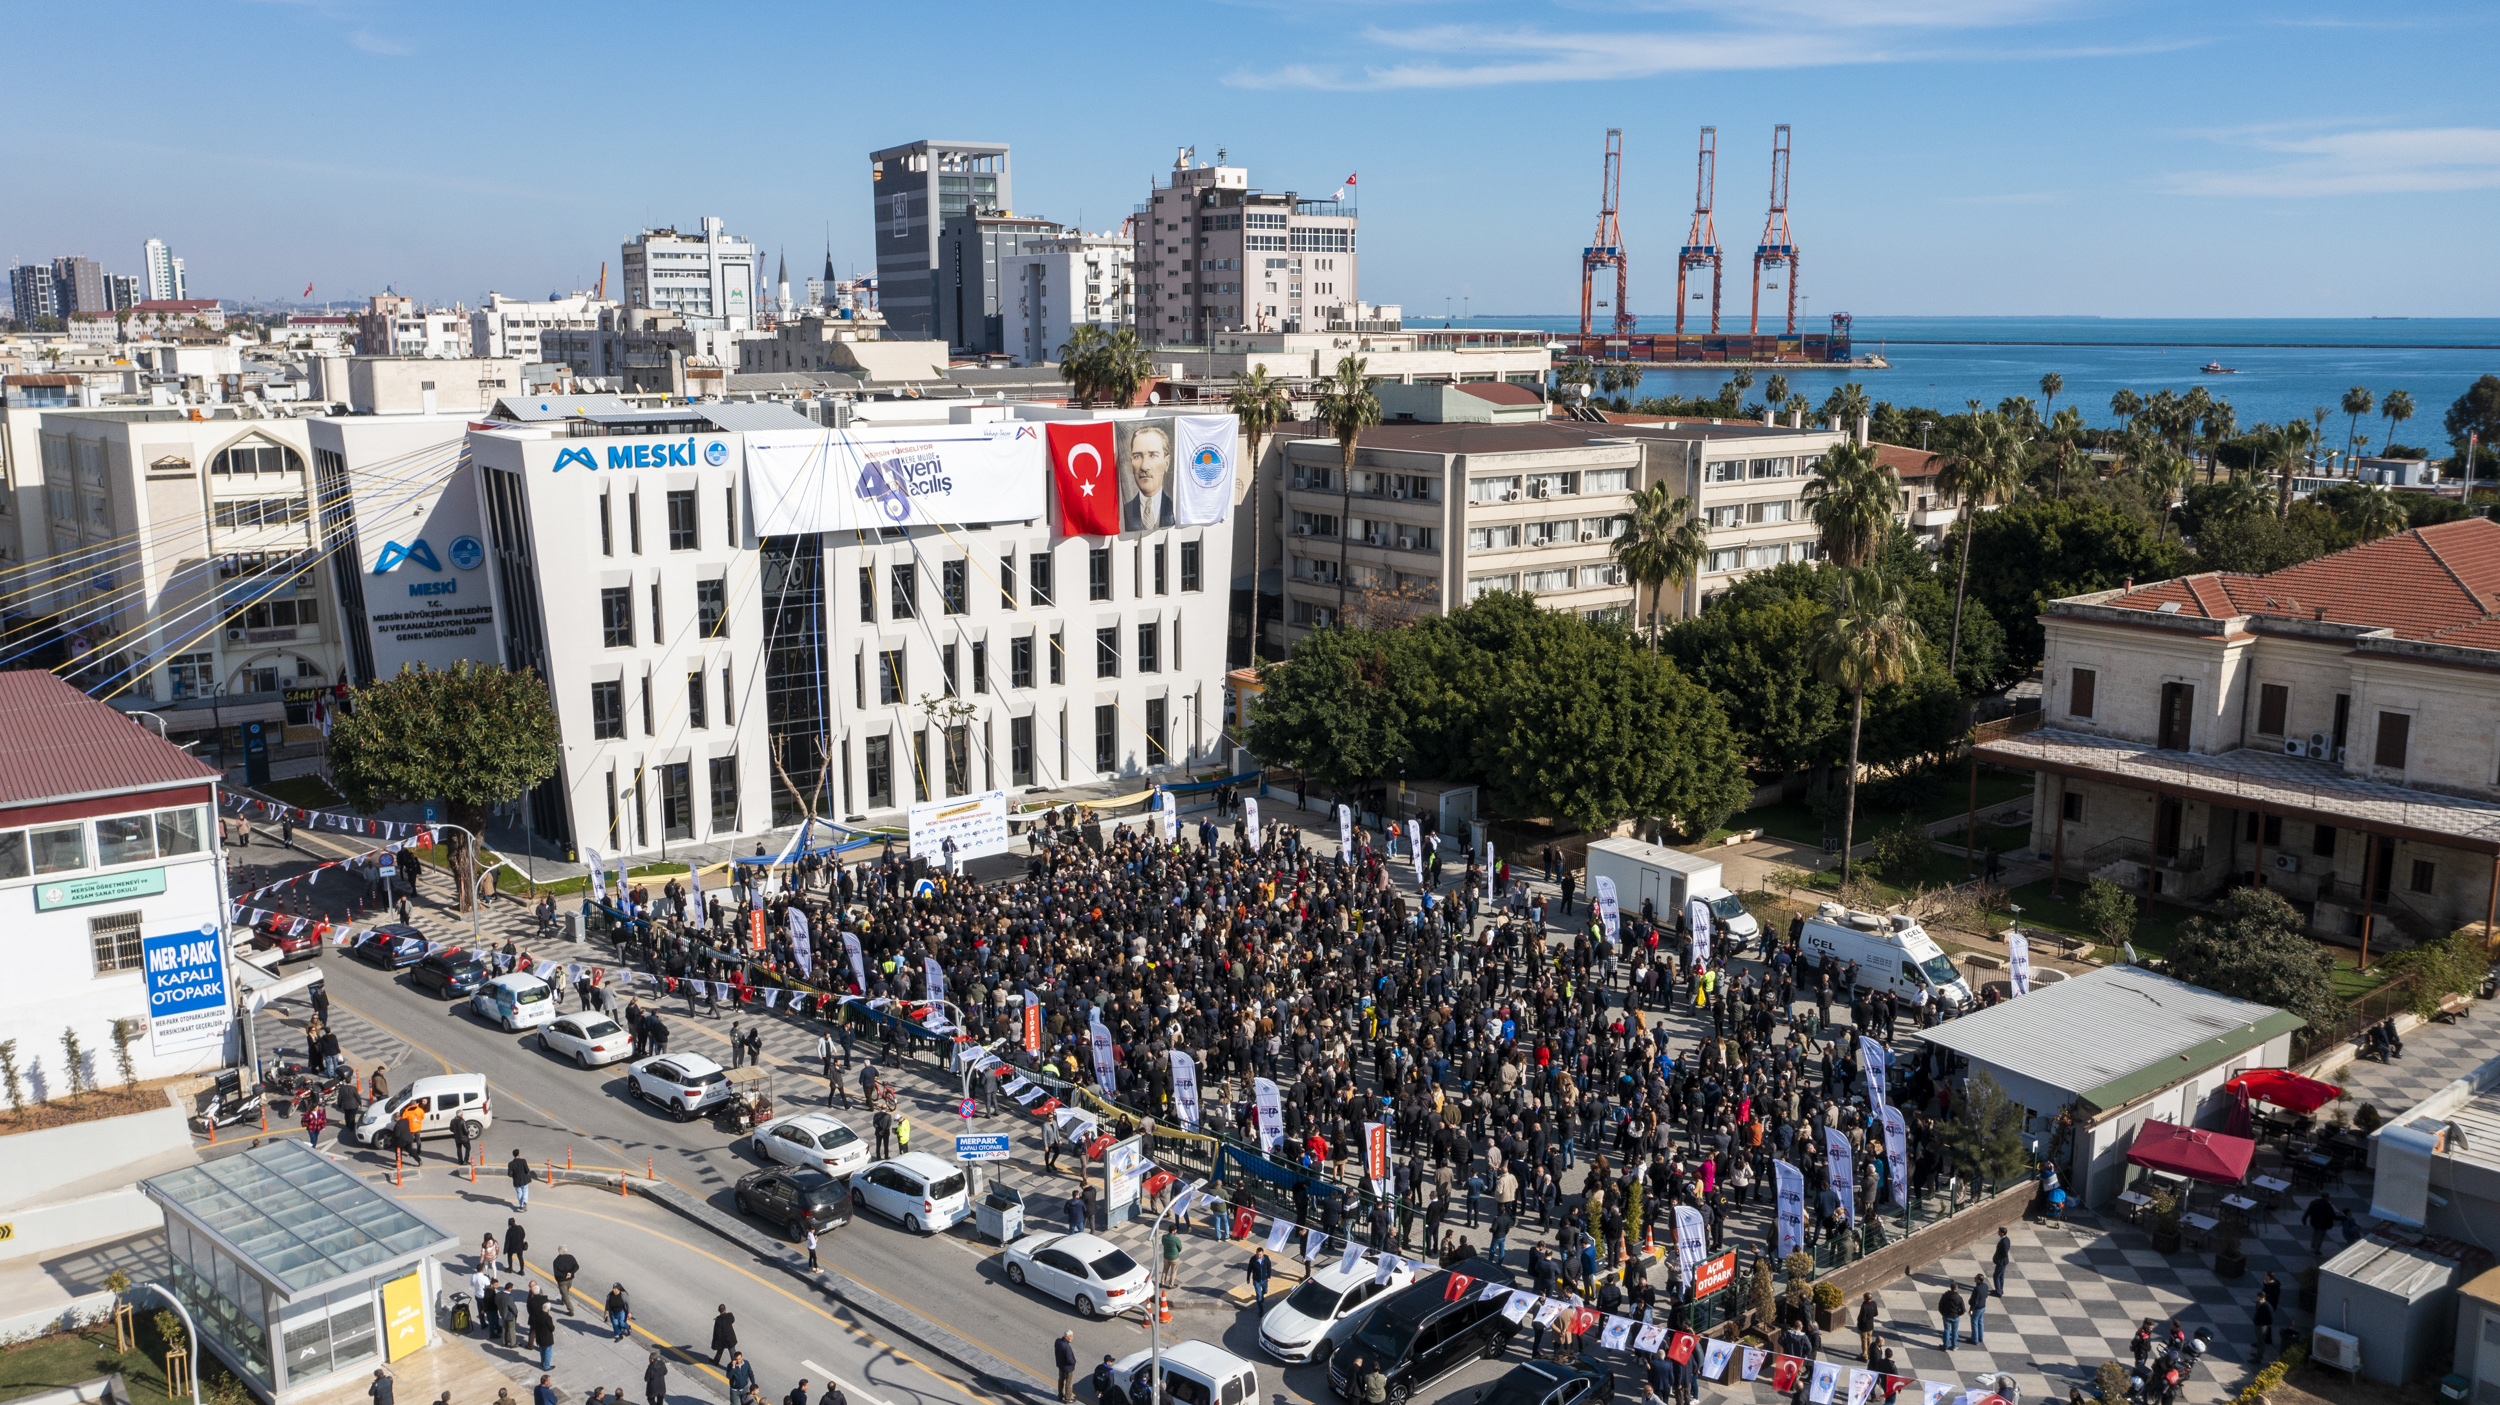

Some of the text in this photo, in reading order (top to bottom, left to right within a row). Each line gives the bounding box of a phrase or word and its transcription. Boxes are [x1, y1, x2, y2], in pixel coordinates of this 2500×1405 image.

[607, 437, 696, 469] MESKİ
[891, 443, 934, 456] YÜKSELİYOR
[901, 452, 936, 465] KERE MÜJDE
[903, 455, 942, 482] yeni
[854, 457, 910, 503] 41
[909, 474, 953, 499] açılış
[408, 577, 457, 597] MESKİ
[373, 604, 493, 622] MERSİN BÜYÜKŞEHİR BELEDİYES
[427, 600, 443, 608] T.C.
[378, 624, 389, 633] SU
[463, 614, 492, 626] İDARESİ
[396, 626, 476, 641] GENEL MÜDÜRLÜĞÜ
[71, 885, 95, 895] MERSİN
[96, 878, 140, 891] ÖĞRETMENEVİ
[71, 886, 138, 901] AKŞAM SANAT OKULU
[1904, 928, 1922, 939] İÇEL
[1808, 935, 1836, 951] İÇEL
[150, 939, 217, 973] MER-PARK
[157, 967, 213, 988] KAPALI
[151, 981, 222, 1006] OTOPARK
[155, 1009, 226, 1027] MER-PARK OTOPARKLARIMIZDA
[960, 1137, 997, 1145] MERPARK
[1706, 1258, 1725, 1275] AÇIK
[1698, 1267, 1732, 1291] OTOPARK
